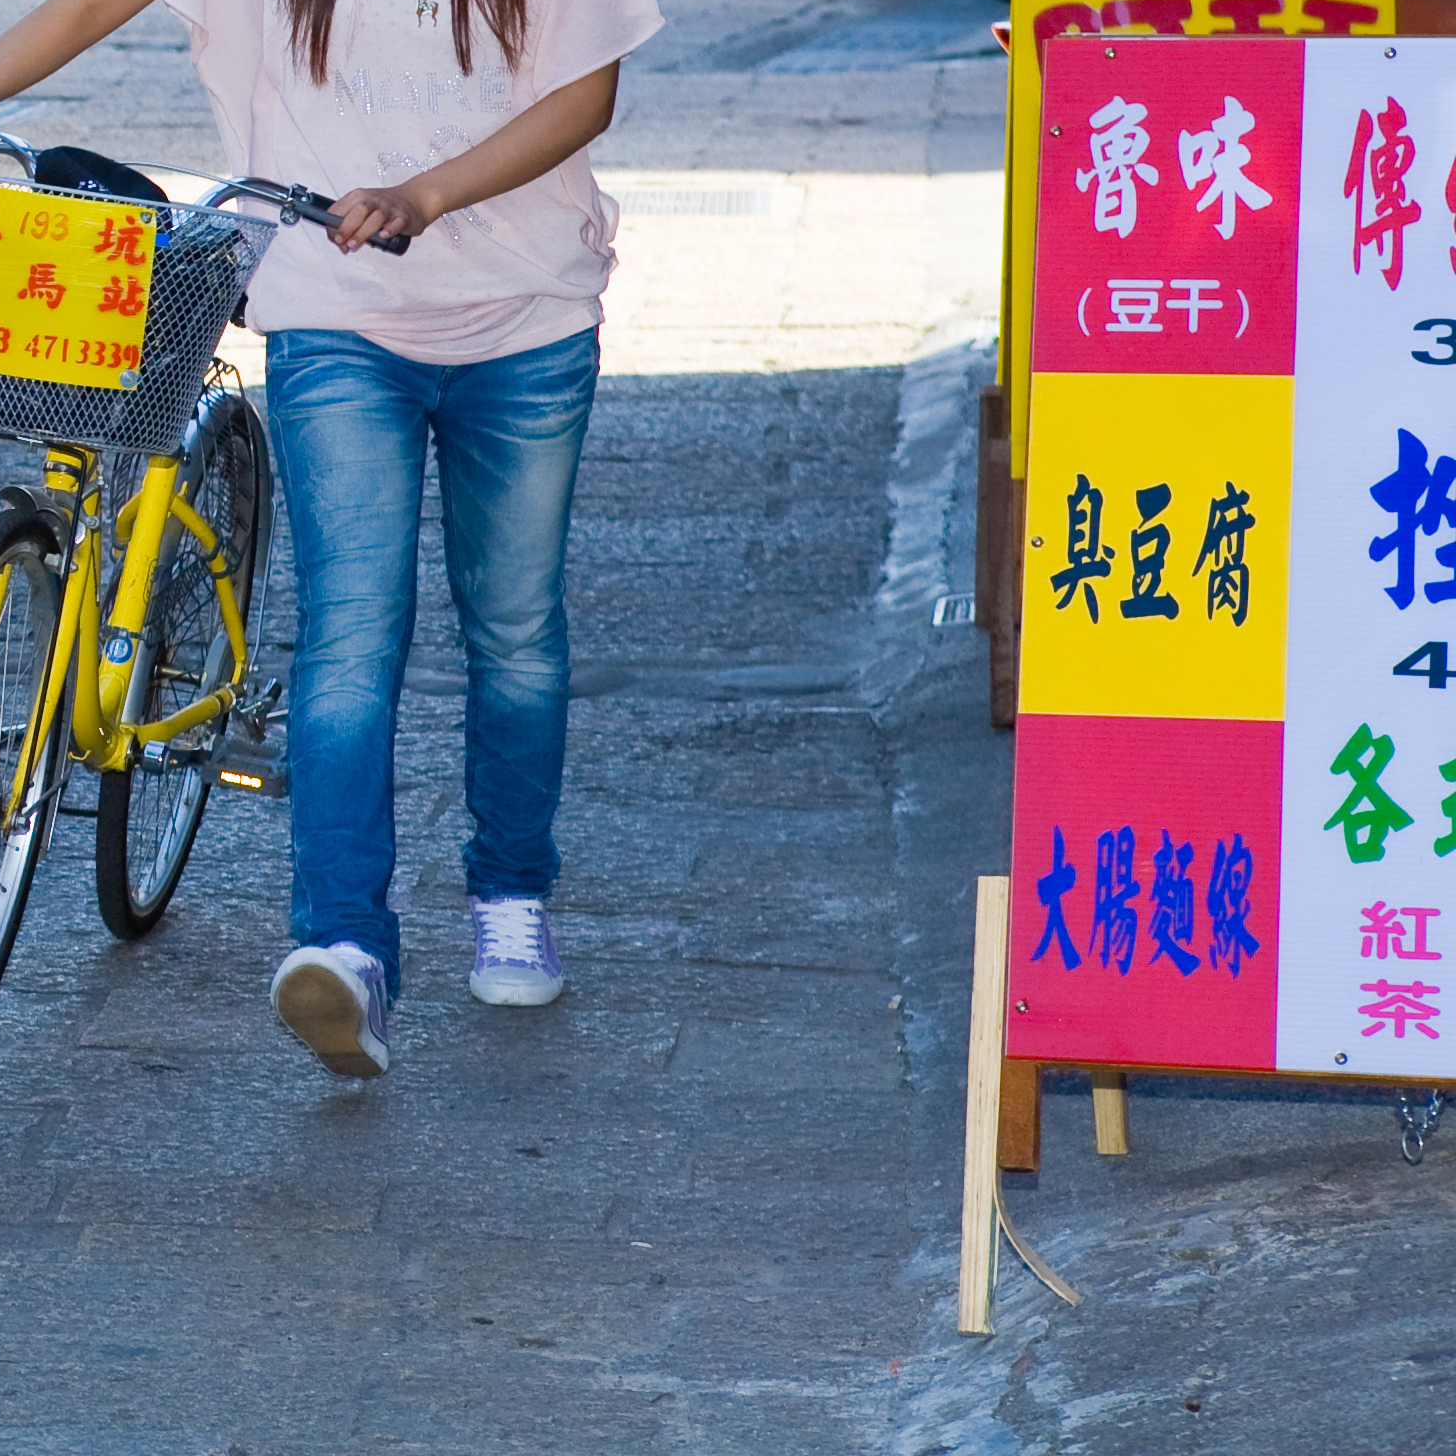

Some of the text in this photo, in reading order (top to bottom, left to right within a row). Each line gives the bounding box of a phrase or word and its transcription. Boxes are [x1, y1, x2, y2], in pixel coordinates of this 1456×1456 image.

[334, 66, 512, 116] MAKE
[20, 210, 70, 243] 193
[1075, 95, 1274, 241] 魯味
[1344, 96, 1456, 292] 傳
[25, 334, 140, 371] 4713339
[1048, 473, 1257, 627] 臭豆腐
[1323, 723, 1456, 865] 各
[1031, 824, 1260, 980] 大腸麵線
[1359, 900, 1442, 1039] 紅茶
